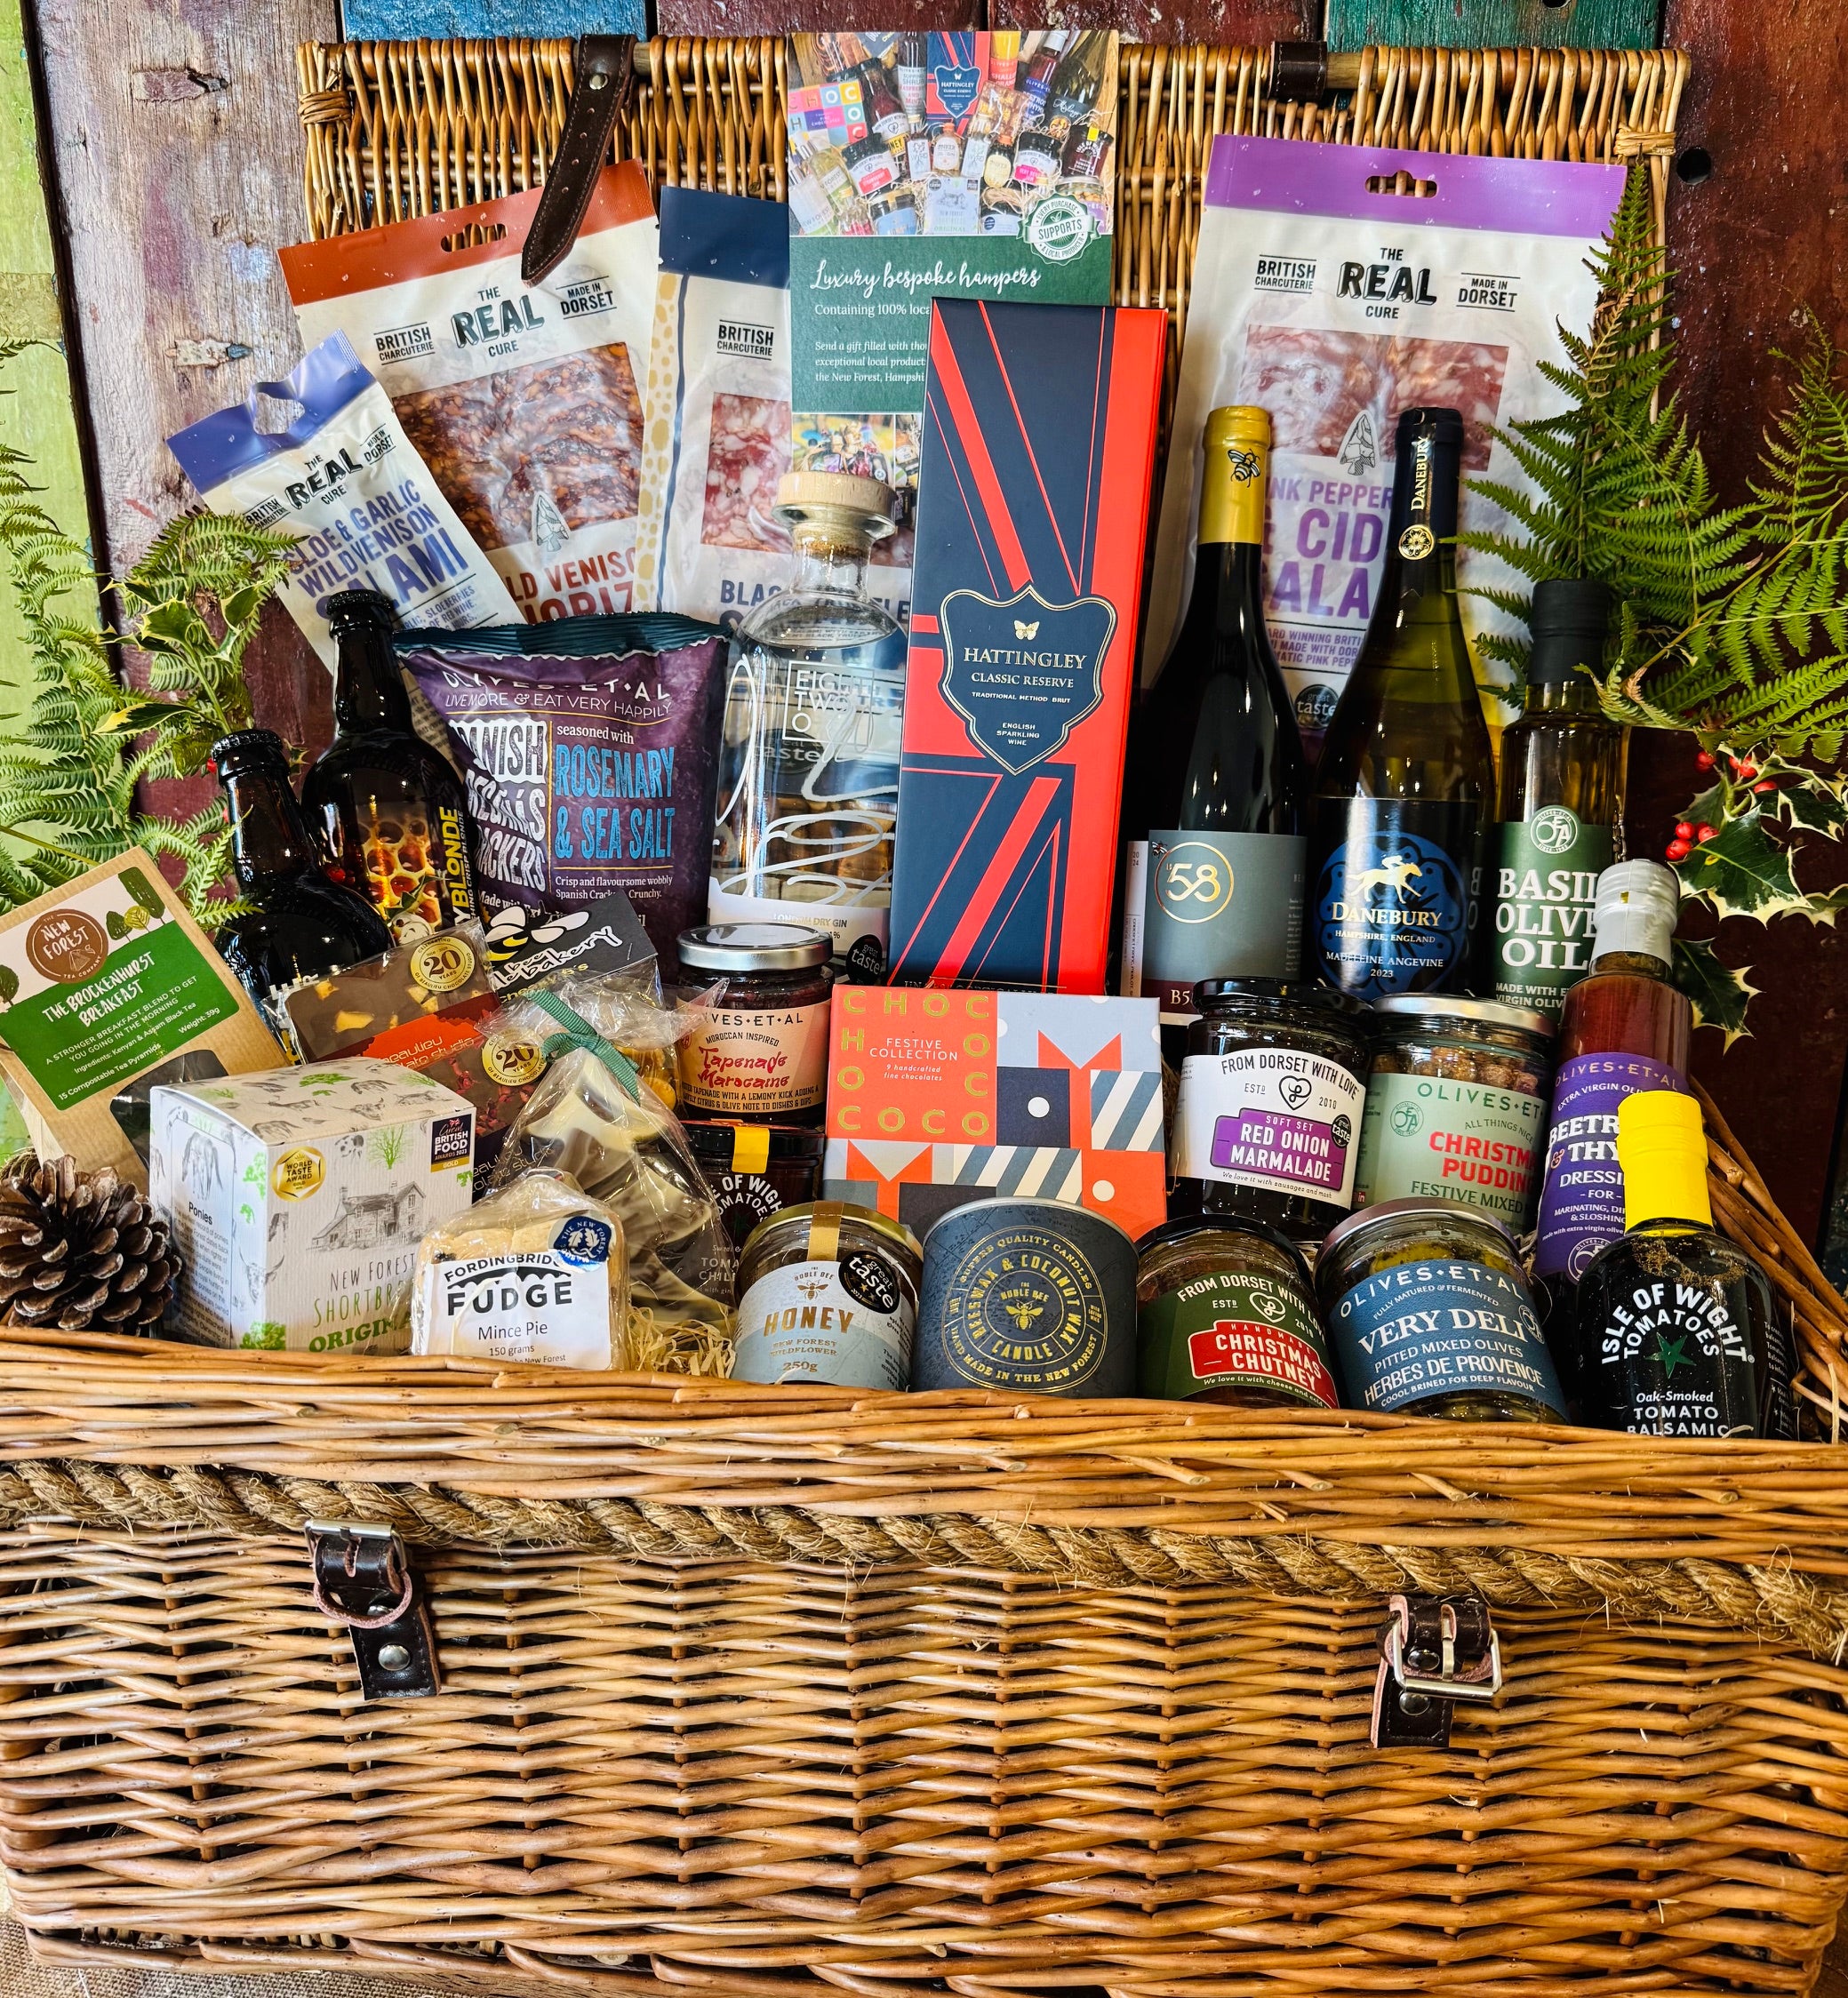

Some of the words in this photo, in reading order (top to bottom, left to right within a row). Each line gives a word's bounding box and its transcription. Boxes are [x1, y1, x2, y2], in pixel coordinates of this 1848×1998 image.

[1038, 220, 1082, 240] SUPPORTS
[1380, 248, 1404, 261] THE
[811, 260, 880, 299] Luxury
[884, 261, 956, 295] bespoke
[959, 261, 1041, 294] hampers
[1257, 260, 1316, 279] BRITISH
[568, 285, 591, 299] MADE
[592, 284, 601, 292] IN
[1255, 276, 1313, 290] CHARCUTERIE
[1336, 262, 1437, 306] REAL
[1471, 278, 1495, 289] MADE
[1498, 280, 1508, 290] IN
[478, 286, 501, 302] THE
[560, 292, 614, 315] DORSET
[1458, 290, 1517, 308] DORSET
[451, 295, 544, 348] REAL
[1365, 306, 1399, 319] CURE
[375, 327, 432, 351] BRITISH
[719, 324, 774, 346] BRITISH
[379, 341, 435, 361] CHARCUTERIE
[489, 340, 519, 357] CURE
[717, 340, 772, 356] CHARCUTERIE
[815, 342, 836, 351] Send
[846, 341, 862, 353] gift
[864, 341, 885, 351] filled
[815, 357, 865, 368] exceptional
[868, 357, 888, 366] local
[304, 455, 324, 471] THE
[1411, 436, 1429, 511] DANEBURY
[284, 448, 364, 510] REAL
[321, 485, 347, 505] CURE
[1290, 630, 1332, 643] WINNING
[964, 648, 1087, 668] HATTINGLEY
[972, 673, 1020, 685] CLASSIC
[1023, 676, 1074, 688] RESERVE
[1308, 692, 1330, 702] great
[556, 724, 609, 740] seasoned
[611, 731, 634, 744] with
[996, 730, 1039, 739] SPARKLING
[555, 744, 675, 798] ROSEMARY
[556, 806, 572, 859] &
[581, 807, 622, 859] SEA
[630, 808, 675, 859] SALT
[439, 806, 469, 907] BLONDE
[556, 875, 578, 887] Crisp
[595, 876, 646, 886] flavoursome
[648, 875, 673, 887] wobbly
[1332, 902, 1443, 926] DANEBURY
[41, 920, 71, 941] NEW
[43, 926, 90, 960] FOREST
[424, 949, 460, 978] 20
[852, 948, 881, 975] taste
[1502, 938, 1589, 971] OIL
[1371, 969, 1394, 978] 2023
[43, 1003, 69, 1023] THE
[66, 951, 156, 1012] BROCKENHURST
[1496, 982, 1524, 994] MADE
[1525, 986, 1556, 995] WITH
[79, 979, 144, 1027] BREAKFAST
[53, 1036, 96, 1061] STRONGER
[97, 1012, 140, 1040] BREAKFAST
[143, 993, 169, 1011] BLEND
[170, 986, 182, 995] TO
[181, 977, 197, 987] GET
[68, 1052, 86, 1062] YOU
[88, 1039, 114, 1052] GOING
[124, 1021, 141, 1035] THE
[142, 997, 179, 1024] MORNING
[706, 1032, 742, 1044] MOROCCAN
[746, 1033, 779, 1046] INSPIRED
[886, 1038, 941, 1050] FESTIVE
[699, 1046, 788, 1073] Tapenade
[869, 1048, 958, 1061] COLLECTION
[884, 1072, 899, 1081] fine
[901, 1073, 942, 1083] chocolates
[1221, 1055, 1254, 1075] FROM
[1260, 1054, 1308, 1073] DORSET
[1312, 1060, 1337, 1084] WITH
[1339, 1073, 1359, 1101] LOVE
[1557, 1091, 1580, 1112] EXTRA
[1581, 1083, 1619, 1094] VIRGIN
[1266, 1115, 1291, 1127] SOFT
[1297, 1122, 1313, 1131] SET
[1465, 1121, 1482, 1130] ALL
[1484, 1119, 1517, 1131] THINGS
[1518, 1128, 1533, 1144] NICE
[435, 1131, 468, 1145] BRITISH
[435, 1139, 468, 1155] FOOD
[1241, 1123, 1274, 1146] RED
[1281, 1131, 1330, 1157] ONION
[286, 1160, 312, 1170] WORLD
[286, 1167, 312, 1177] TASTE
[1231, 1145, 1332, 1182] MARMALADE
[286, 1173, 312, 1183] AWARD
[723, 1175, 743, 1192] OF
[189, 1202, 212, 1225] Ponies
[1542, 1231, 1554, 1241] made
[1554, 1227, 1566, 1236] with
[1567, 1226, 1583, 1235] extra
[1584, 1225, 1605, 1235] virgin
[331, 1267, 360, 1291] NEW
[370, 1253, 414, 1281] FOREST
[960, 1244, 994, 1283] SUPERB
[997, 1235, 1050, 1247] QUALITY
[1052, 1244, 1092, 1290] CANDLES
[849, 1257, 894, 1308] taste
[868, 1260, 893, 1289] great
[447, 1282, 572, 1315] FUDGE
[1177, 1276, 1217, 1303] FROM
[1220, 1275, 1273, 1293] DORSET
[1278, 1285, 1305, 1314] WITH
[478, 1324, 522, 1340] Mince
[526, 1322, 548, 1335] Pie
[764, 1307, 854, 1337] HONEY
[1357, 1310, 1440, 1355] VERY
[1448, 1308, 1529, 1343] DELI
[1602, 1305, 1635, 1364] ISLE
[1633, 1283, 1665, 1310] OF
[1676, 1284, 1748, 1362] WIGHT
[1623, 1309, 1720, 1359] TOMATOES
[490, 1347, 507, 1355] 150
[508, 1345, 534, 1358] grams
[951, 1327, 965, 1355] HAND
[964, 1355, 992, 1375] MADE
[996, 1371, 1010, 1379] IN
[1045, 1367, 1070, 1381] NEW
[1071, 1334, 1097, 1371] FOREST
[992, 1340, 1053, 1360] CANDLE
[1216, 1334, 1322, 1379] CHRISTMAS
[1374, 1347, 1418, 1373] PITTED
[1421, 1339, 1470, 1354] MIXED
[1474, 1339, 1524, 1357] OLIVES
[1232, 1353, 1316, 1391] CHUTNEY
[1364, 1361, 1423, 1406] HERBES
[1428, 1357, 1453, 1377] DE
[1456, 1355, 1545, 1388] PROVENCE
[1636, 1391, 1714, 1403] Oak-Smoked
[1633, 1406, 1718, 1419] TOMATO
